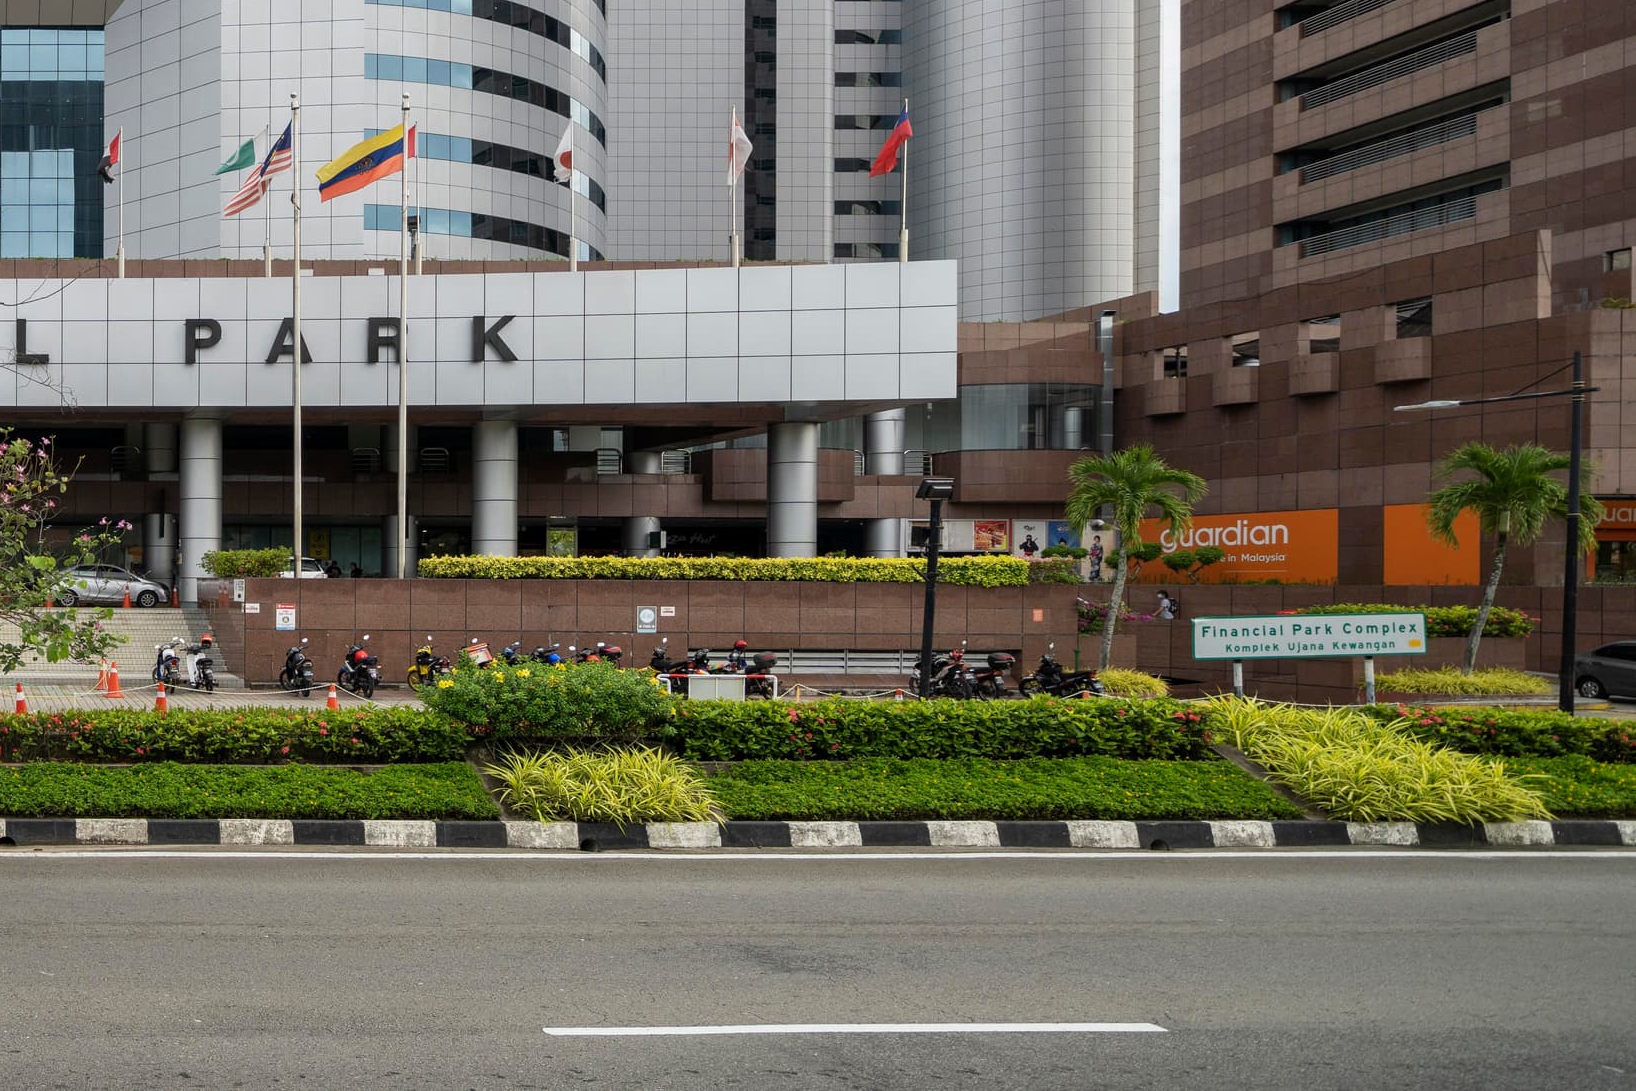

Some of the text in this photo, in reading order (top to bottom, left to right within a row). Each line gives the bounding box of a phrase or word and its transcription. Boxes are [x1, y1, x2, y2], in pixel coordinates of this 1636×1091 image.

[184, 315, 519, 364] PARK
[1160, 520, 1289, 554] guardian
[1241, 553, 1286, 564] Malaysia
[1201, 622, 1417, 638] Financial Park Complex
[1225, 641, 1396, 654] Komplek Ujana Kewangan
